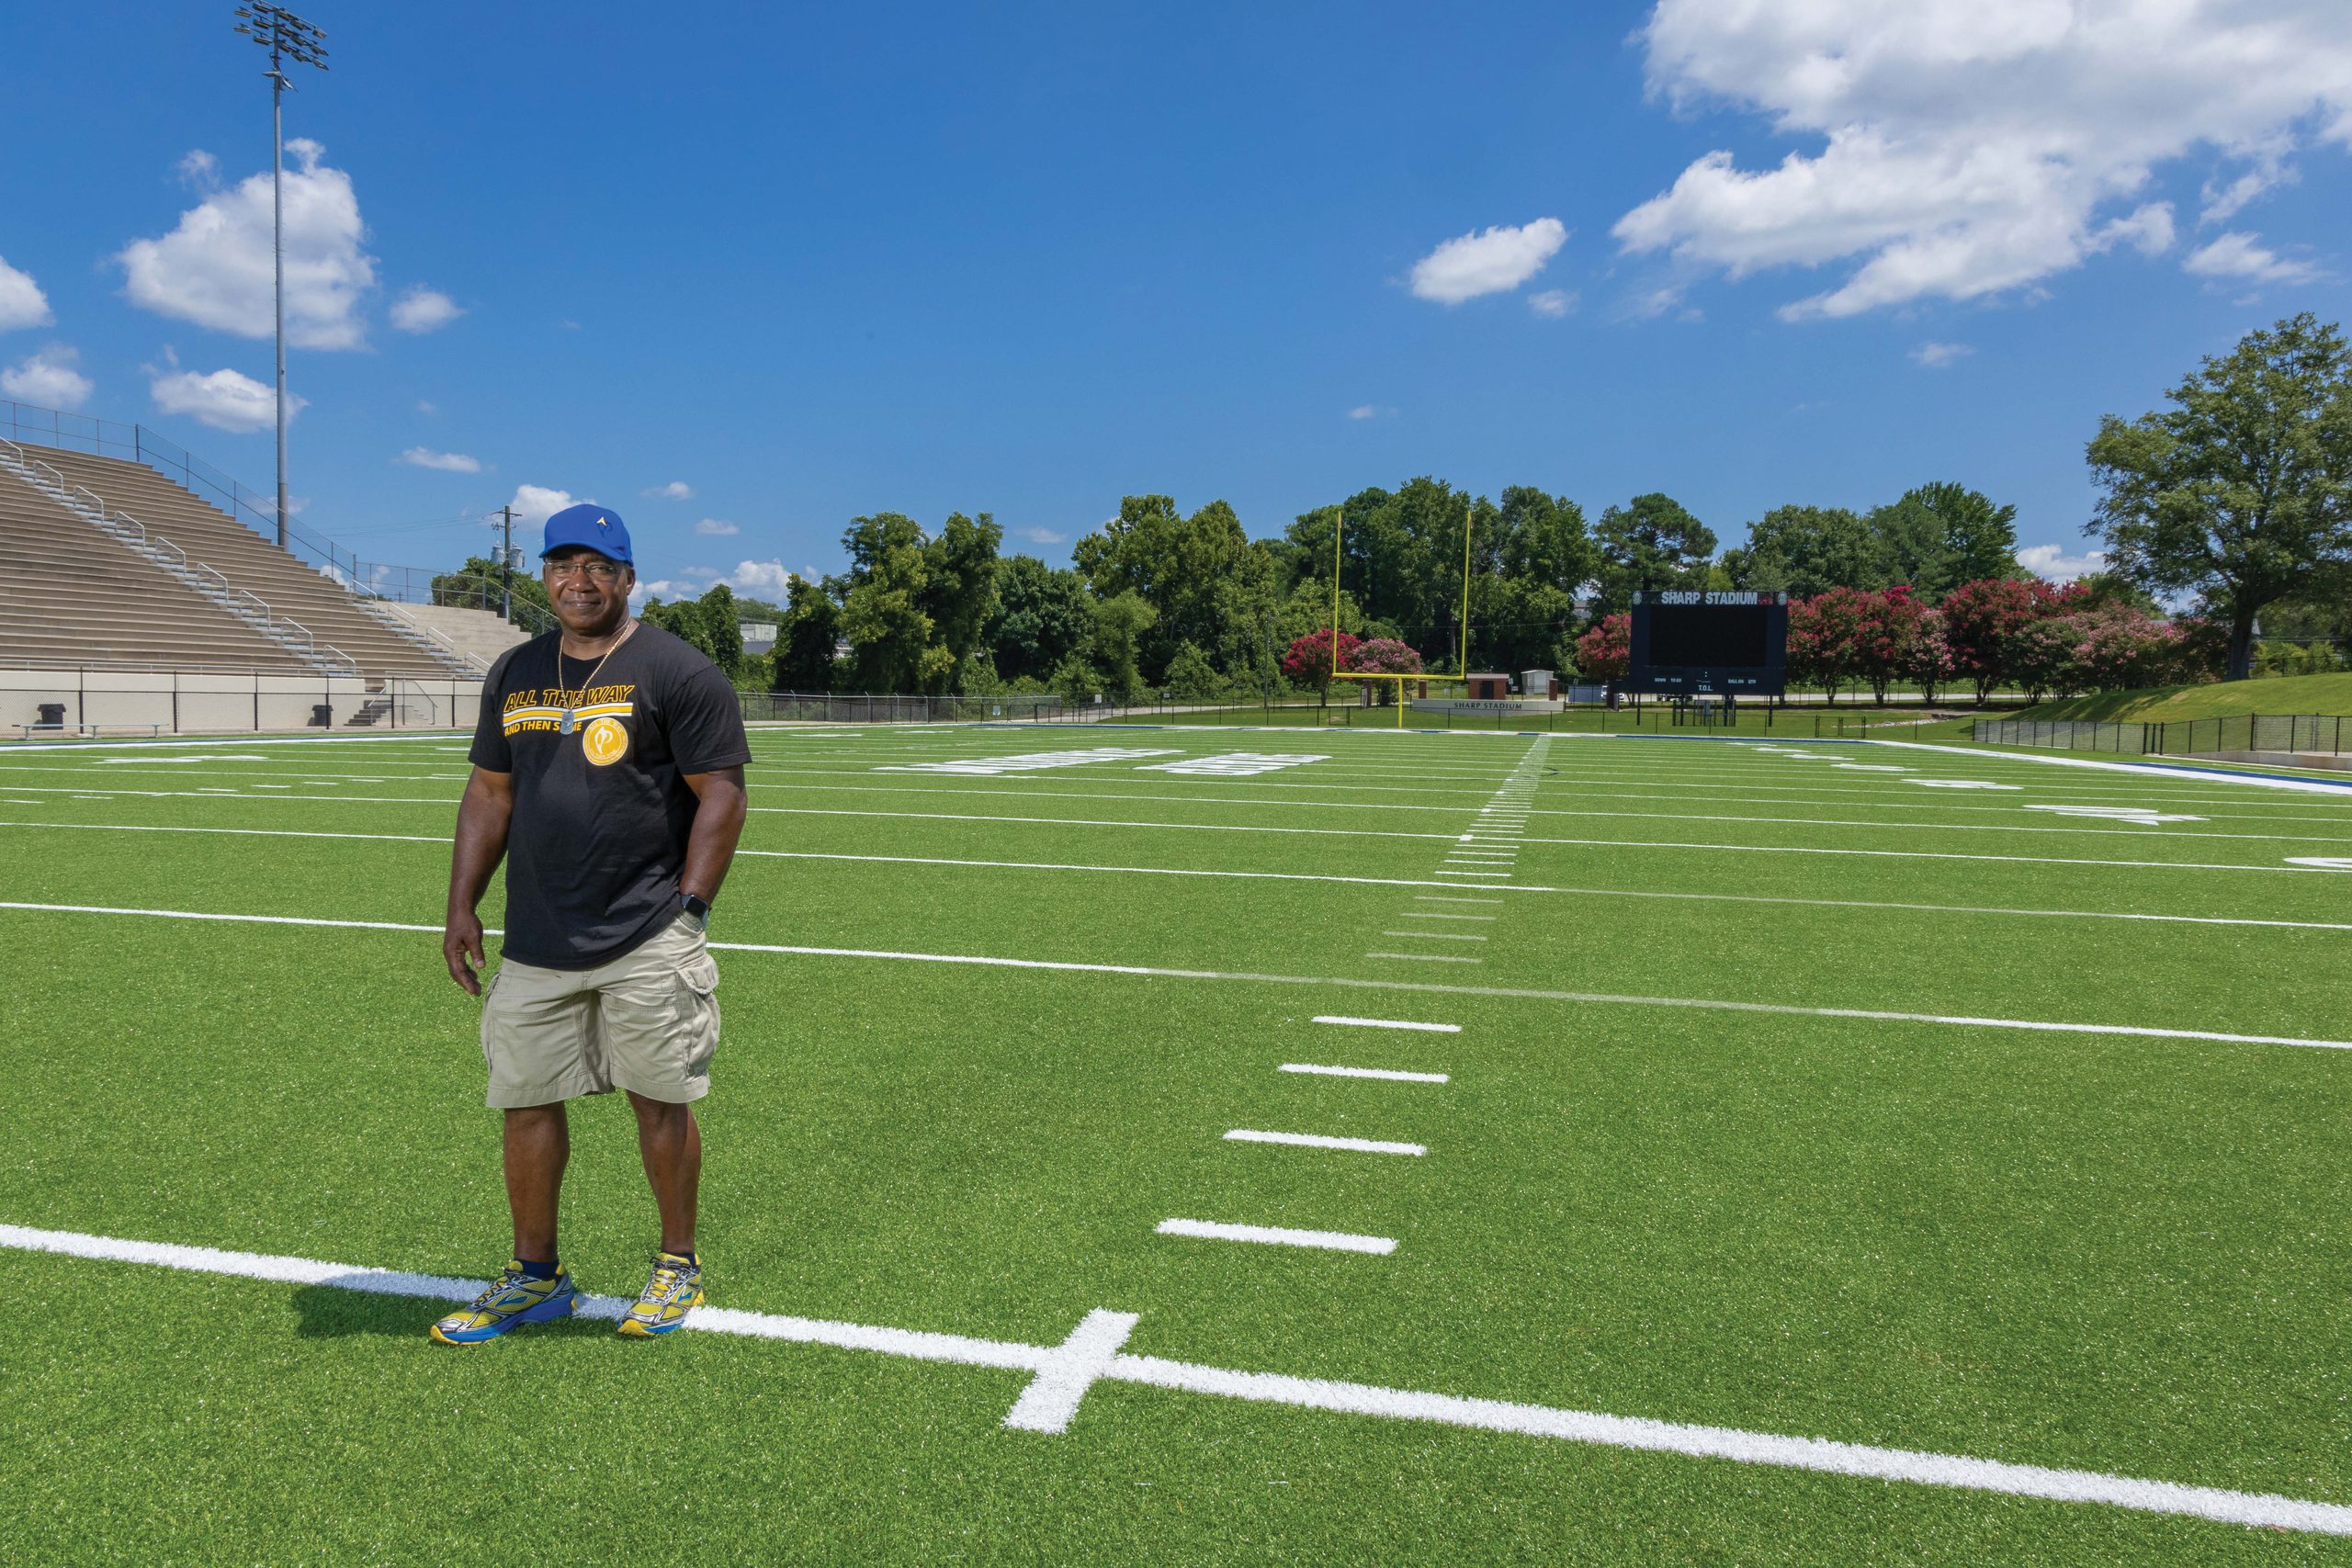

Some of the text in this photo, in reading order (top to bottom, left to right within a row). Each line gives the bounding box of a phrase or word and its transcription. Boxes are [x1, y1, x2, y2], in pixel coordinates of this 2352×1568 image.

[1661, 591, 1758, 604] SHARP STADIUM
[503, 684, 636, 713] ALL THE WAY
[504, 723, 520, 737] AND
[522, 720, 551, 731] THEN
